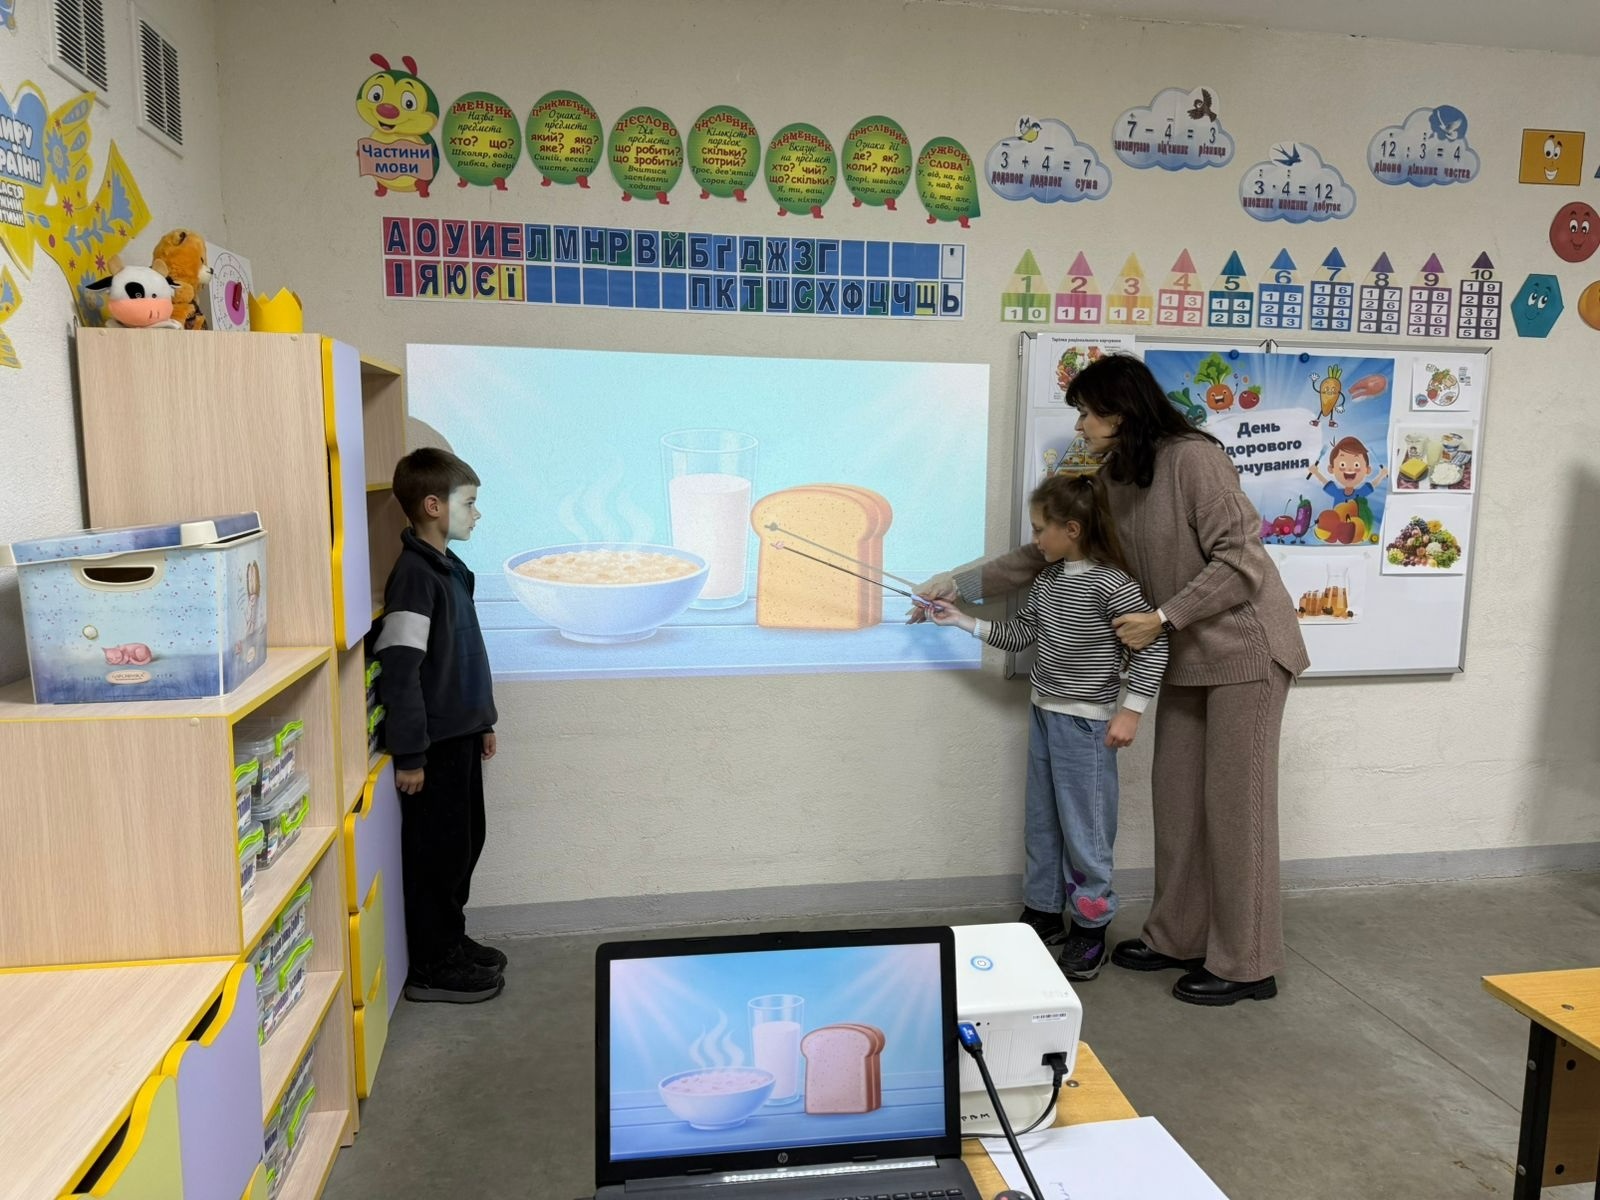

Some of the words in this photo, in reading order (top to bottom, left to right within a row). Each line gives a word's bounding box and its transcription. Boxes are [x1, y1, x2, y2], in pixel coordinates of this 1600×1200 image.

[453, 101, 512, 118] ІМЕННИК
[468, 111, 494, 123] Назва
[532, 99, 597, 119] ПРИКМЕТНИК
[549, 110, 580, 121] Ознака
[0, 114, 32, 149] ИРУ
[616, 115, 677, 136] ДІЄСЛОВО
[695, 113, 756, 135] ЧИСЛІВНИК
[531, 132, 564, 142] який?
[574, 136, 599, 144] яка?
[770, 130, 832, 151] ЗАЙМЕННИК
[849, 124, 908, 144] ПРИСЛІВНИК
[1127, 121, 1137, 138] 7
[1165, 124, 1172, 140] 4
[1209, 127, 1215, 144] 3
[449, 136, 478, 147] хто?
[489, 139, 514, 150] що?
[540, 144, 564, 153] яке?
[570, 145, 591, 154] які?
[615, 145, 631, 153] що
[636, 145, 680, 156] робити?
[701, 146, 747, 156] скільки?
[362, 145, 430, 158] Частини
[452, 149, 490, 159] Школяр,
[852, 151, 872, 160] де?
[882, 154, 899, 163] як?
[919, 146, 971, 166] СЛУЖБОВІ
[1381, 141, 1396, 157] 12
[1420, 143, 1426, 159] 3
[1454, 145, 1460, 162] 4
[0, 144, 41, 184] РАЇНІ!
[376, 163, 418, 173] мови
[613, 155, 629, 164] що
[634, 156, 683, 167] зробити?
[703, 157, 746, 167] котрий?
[772, 162, 795, 172] хто?
[802, 165, 827, 175] чий?
[930, 160, 963, 171] СЛОВА
[1001, 152, 1008, 168] 3
[1042, 155, 1050, 172] 4
[1084, 159, 1091, 176] 7
[846, 163, 877, 173] коли?
[881, 165, 911, 176] куди?
[770, 174, 790, 184] що?
[792, 175, 835, 185] скільки?
[1075, 178, 1097, 191] сума
[0, 180, 24, 200] АСТЯ
[1254, 181, 1264, 194] 3
[1282, 181, 1290, 196] 4
[1315, 183, 1333, 199] 12
[388, 221, 406, 251] А
[417, 223, 437, 253] О
[446, 224, 464, 254] У
[475, 226, 495, 255] И
[502, 227, 520, 257] Е
[527, 227, 548, 258] Л
[556, 228, 577, 259] М
[585, 230, 604, 261] Н
[609, 232, 628, 262] Р
[638, 233, 657, 264] В
[664, 232, 684, 268] Й
[691, 238, 709, 267] Б
[741, 240, 762, 270] Д
[768, 241, 787, 271] Ж
[795, 241, 813, 271] З
[818, 243, 836, 273] Г
[420, 264, 439, 295] Я
[449, 265, 466, 295] Ю
[477, 266, 495, 295] Є
[692, 277, 710, 307] П
[717, 278, 735, 308] К
[742, 279, 760, 309] Т
[768, 281, 788, 309] Ш
[795, 281, 812, 310] С
[818, 282, 835, 311] Х
[843, 282, 863, 311] Ф
[870, 283, 886, 313] Ц
[894, 283, 910, 313] Ч
[917, 285, 935, 314] Щ
[943, 284, 959, 312] Ь
[1021, 276, 1032, 292] 1
[1071, 277, 1088, 293] 2
[1124, 278, 1140, 295] 3
[1173, 273, 1191, 290] 4
[1224, 276, 1240, 290] 5
[1275, 271, 1292, 284] 6
[1327, 267, 1341, 281] 7
[1375, 273, 1389, 287] 8
[1424, 273, 1439, 286] 9
[1470, 269, 1493, 280] 10
[1237, 422, 1280, 438] День
[1226, 440, 1301, 458] дорового
[1235, 459, 1309, 476] рчування
